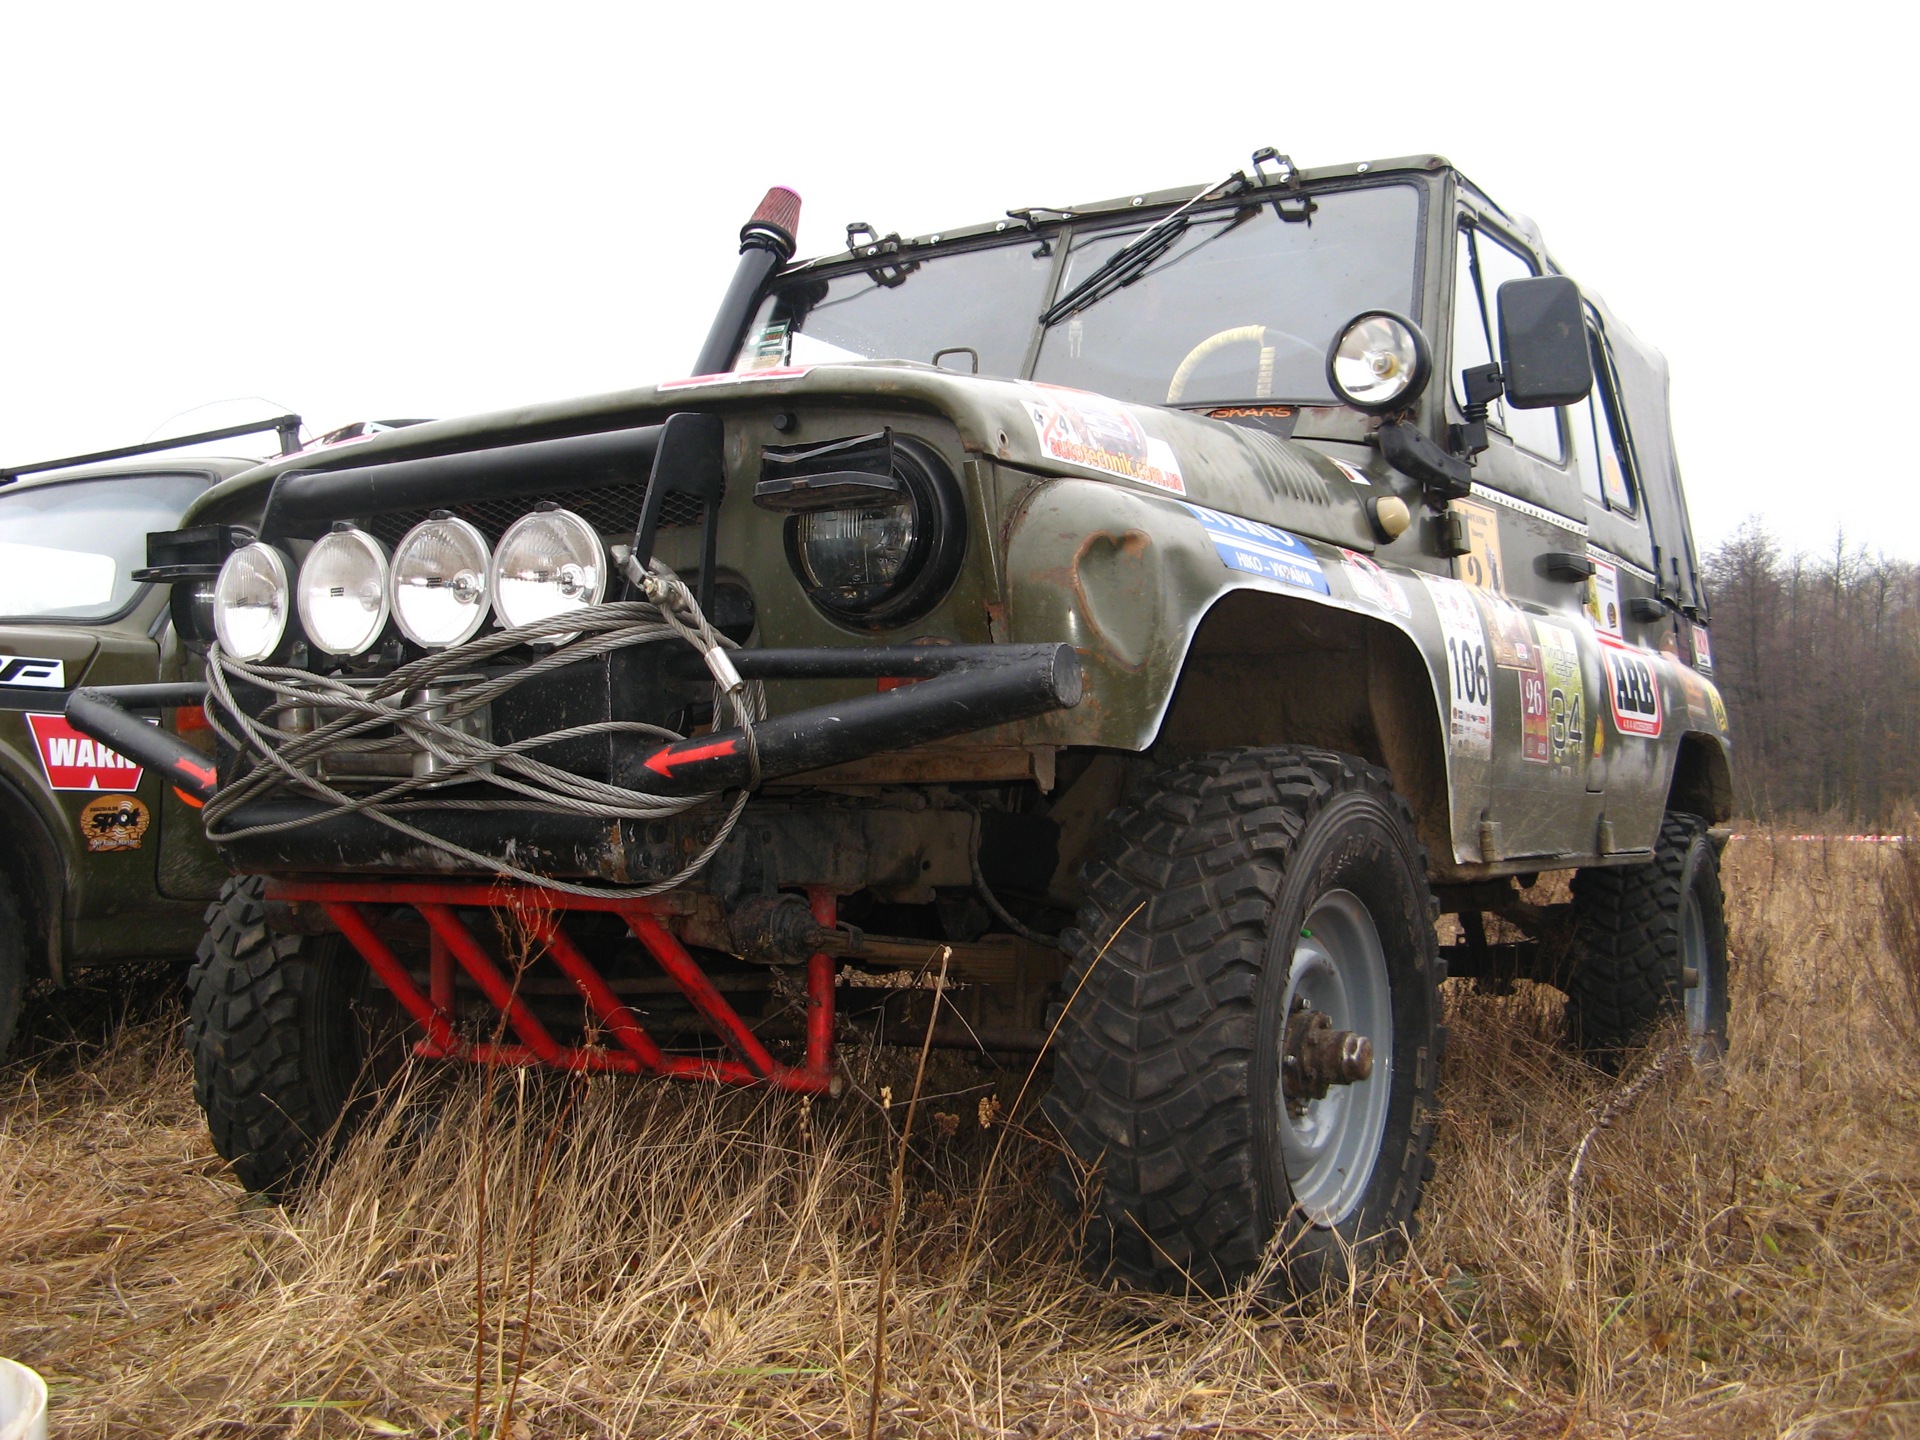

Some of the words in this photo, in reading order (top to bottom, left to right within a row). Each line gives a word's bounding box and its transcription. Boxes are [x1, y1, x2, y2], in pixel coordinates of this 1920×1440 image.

[1050, 438, 1183, 491] autotechnik.com.ua
[1449, 637, 1488, 706] 106
[1610, 653, 1655, 715] ARB
[1550, 688, 1583, 753] 34
